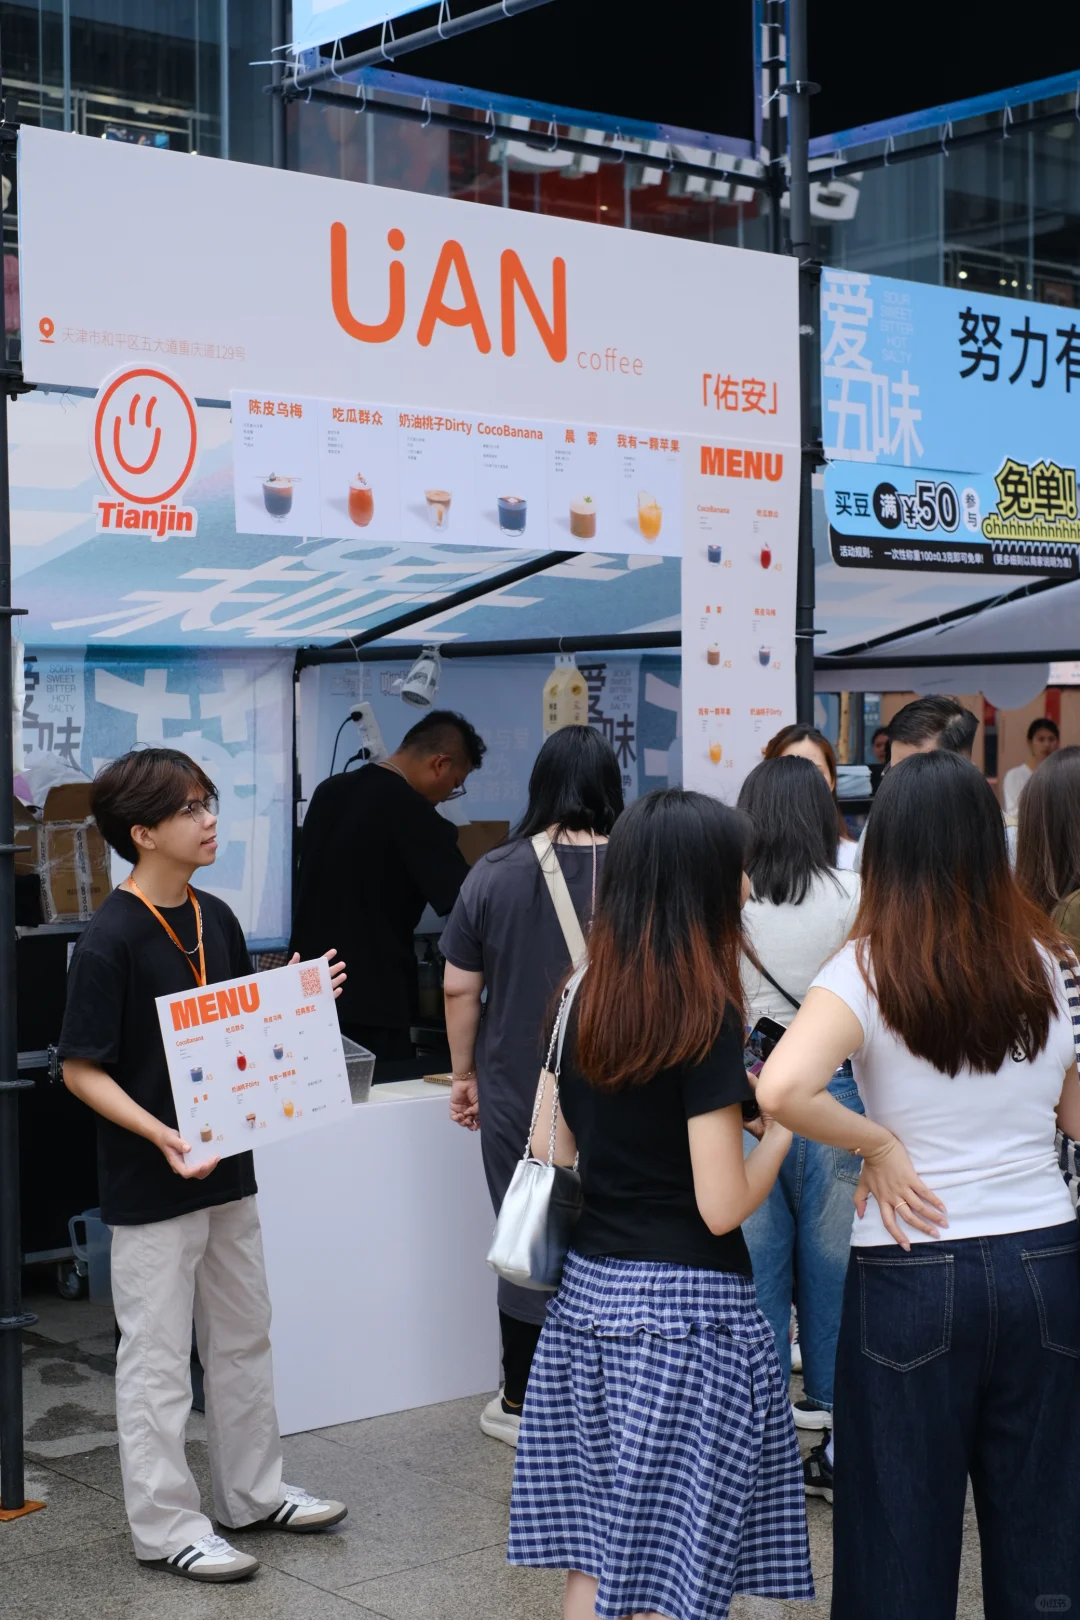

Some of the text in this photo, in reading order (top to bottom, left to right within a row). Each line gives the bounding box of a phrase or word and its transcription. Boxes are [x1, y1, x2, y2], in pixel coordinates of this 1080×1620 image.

[883, 291, 911, 306] SOUR
[822, 271, 873, 371] 爱
[880, 305, 913, 321] SWEET
[880, 319, 914, 335] BITTER
[62, 327, 246, 363] 天津市和平区五大道重庆道129号
[886, 335, 909, 348] HOT
[577, 348, 644, 376] coffee
[881, 348, 912, 364] SALTY
[248, 398, 303, 419] 陈皮乌梅
[332, 407, 384, 426] 吃瓜群众
[823, 365, 925, 467] 五味
[398, 412, 473, 436] 奶油桃子Dirty
[477, 422, 543, 440] CocoBanana
[616, 433, 680, 453] 我有一颗苹果
[700, 445, 783, 482] MENU
[834, 489, 871, 517] 买豆
[97, 502, 193, 537] Tianjin
[49, 664, 74, 674] SOUR
[46, 674, 76, 684] SWEET
[46, 684, 77, 693] BITTER
[52, 694, 72, 703] HOT
[47, 704, 76, 713] SALTY
[169, 982, 261, 1032] MENU
[175, 1035, 205, 1047] CocoBanana
